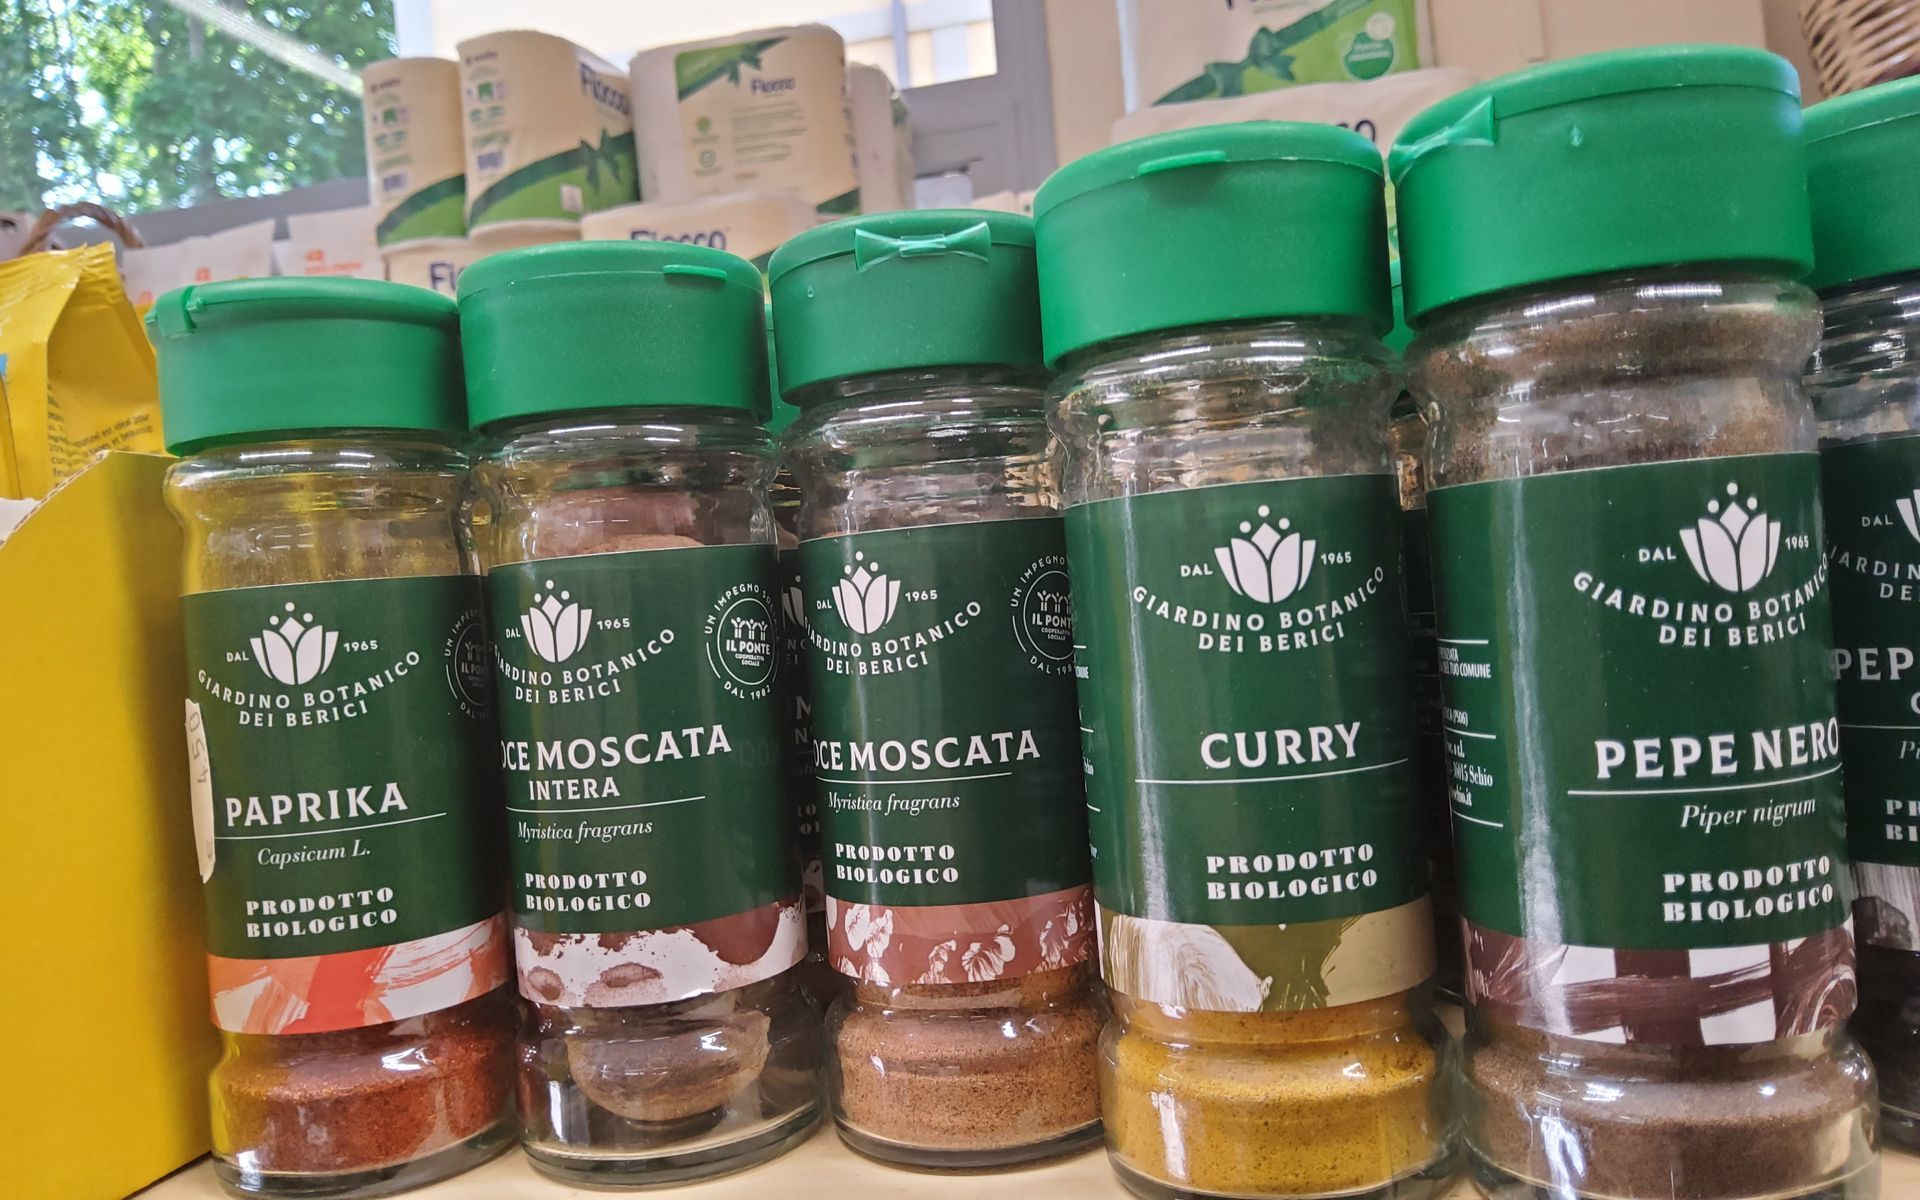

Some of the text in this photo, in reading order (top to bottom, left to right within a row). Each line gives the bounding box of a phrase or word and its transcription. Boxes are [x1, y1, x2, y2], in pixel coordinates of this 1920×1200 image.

[1862, 514, 1894, 528] DAL
[1638, 535, 1810, 563] DAL 1965
[1180, 552, 1352, 577] DAL 1965
[1010, 555, 1065, 607] UN IMPEGNO
[1573, 551, 1829, 624] GIARDINO BOTANICO
[704, 583, 760, 634] UN IMPEGNO
[816, 590, 938, 610] DAL 1965
[1133, 565, 1384, 632] GIARDINO BOTANICO
[506, 618, 630, 639] DAL 1965
[872, 601, 981, 657] BOTANICO
[1032, 613, 1043, 625] IL
[1659, 612, 1806, 648] DEI BERICI
[226, 639, 378, 663] DAL 1965
[726, 639, 737, 652] IL
[739, 641, 770, 655] PONTE
[1199, 621, 1345, 652] DEI BERICI
[562, 629, 675, 685] BOTANICO
[826, 651, 928, 676] DEI BERICI
[1030, 655, 1051, 674] DAL
[1460, 663, 1492, 679] COMUNE
[198, 651, 420, 709] GIARDINO BOTANICO
[515, 678, 621, 704] DEI BERICI
[724, 681, 745, 699] DAL
[239, 700, 368, 728] DEI BERICI
[536, 724, 732, 771] MOSCATA
[850, 730, 1040, 771] MOSCATA
[1200, 721, 1361, 770] CURRY
[1595, 716, 1839, 779] PEPE NERO
[528, 776, 620, 801] INTERA
[1469, 764, 1493, 787] Schio
[225, 782, 408, 827] PAPRIKA
[884, 793, 960, 816] fragrans
[1680, 798, 1816, 834] Piper nigrum
[518, 821, 653, 844] Myristica fragrans
[257, 839, 371, 870] Capsicum L.
[835, 843, 955, 862] PRODOTTO
[1206, 843, 1374, 874] PRODOTTO
[525, 870, 647, 890] PRODOTTO
[836, 864, 958, 884] BIOLOGICO
[1207, 869, 1378, 900] BIOLOGICO
[1662, 855, 1830, 893] PRODOTTO
[246, 886, 394, 916] PRODOTTO
[525, 892, 651, 912] BIOLOGICO
[1663, 883, 1834, 923] BIOLOGICO
[246, 908, 397, 938] BIOLOGICO
